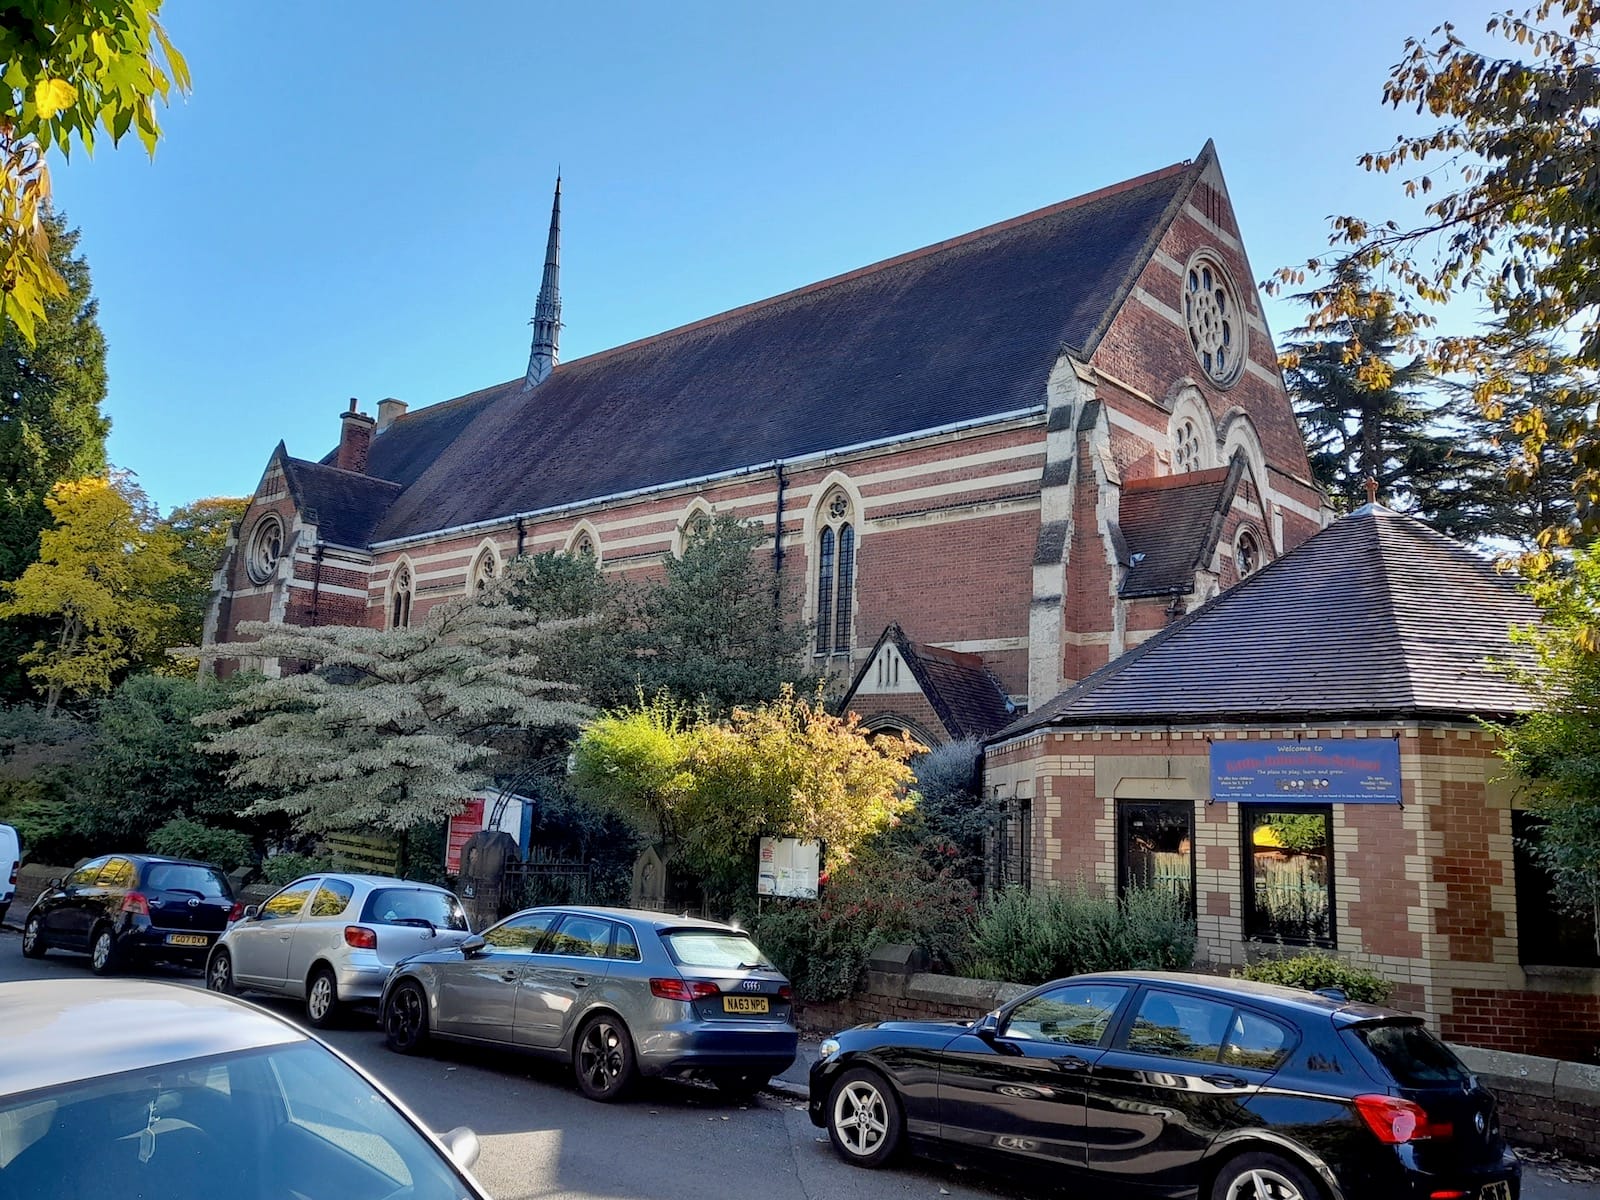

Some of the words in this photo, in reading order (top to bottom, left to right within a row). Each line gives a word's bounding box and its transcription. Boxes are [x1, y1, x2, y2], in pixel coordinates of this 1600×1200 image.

[1277, 744, 1311, 752] Welcome
[727, 998, 749, 1010] NA63
[750, 999, 766, 1011] NPG
